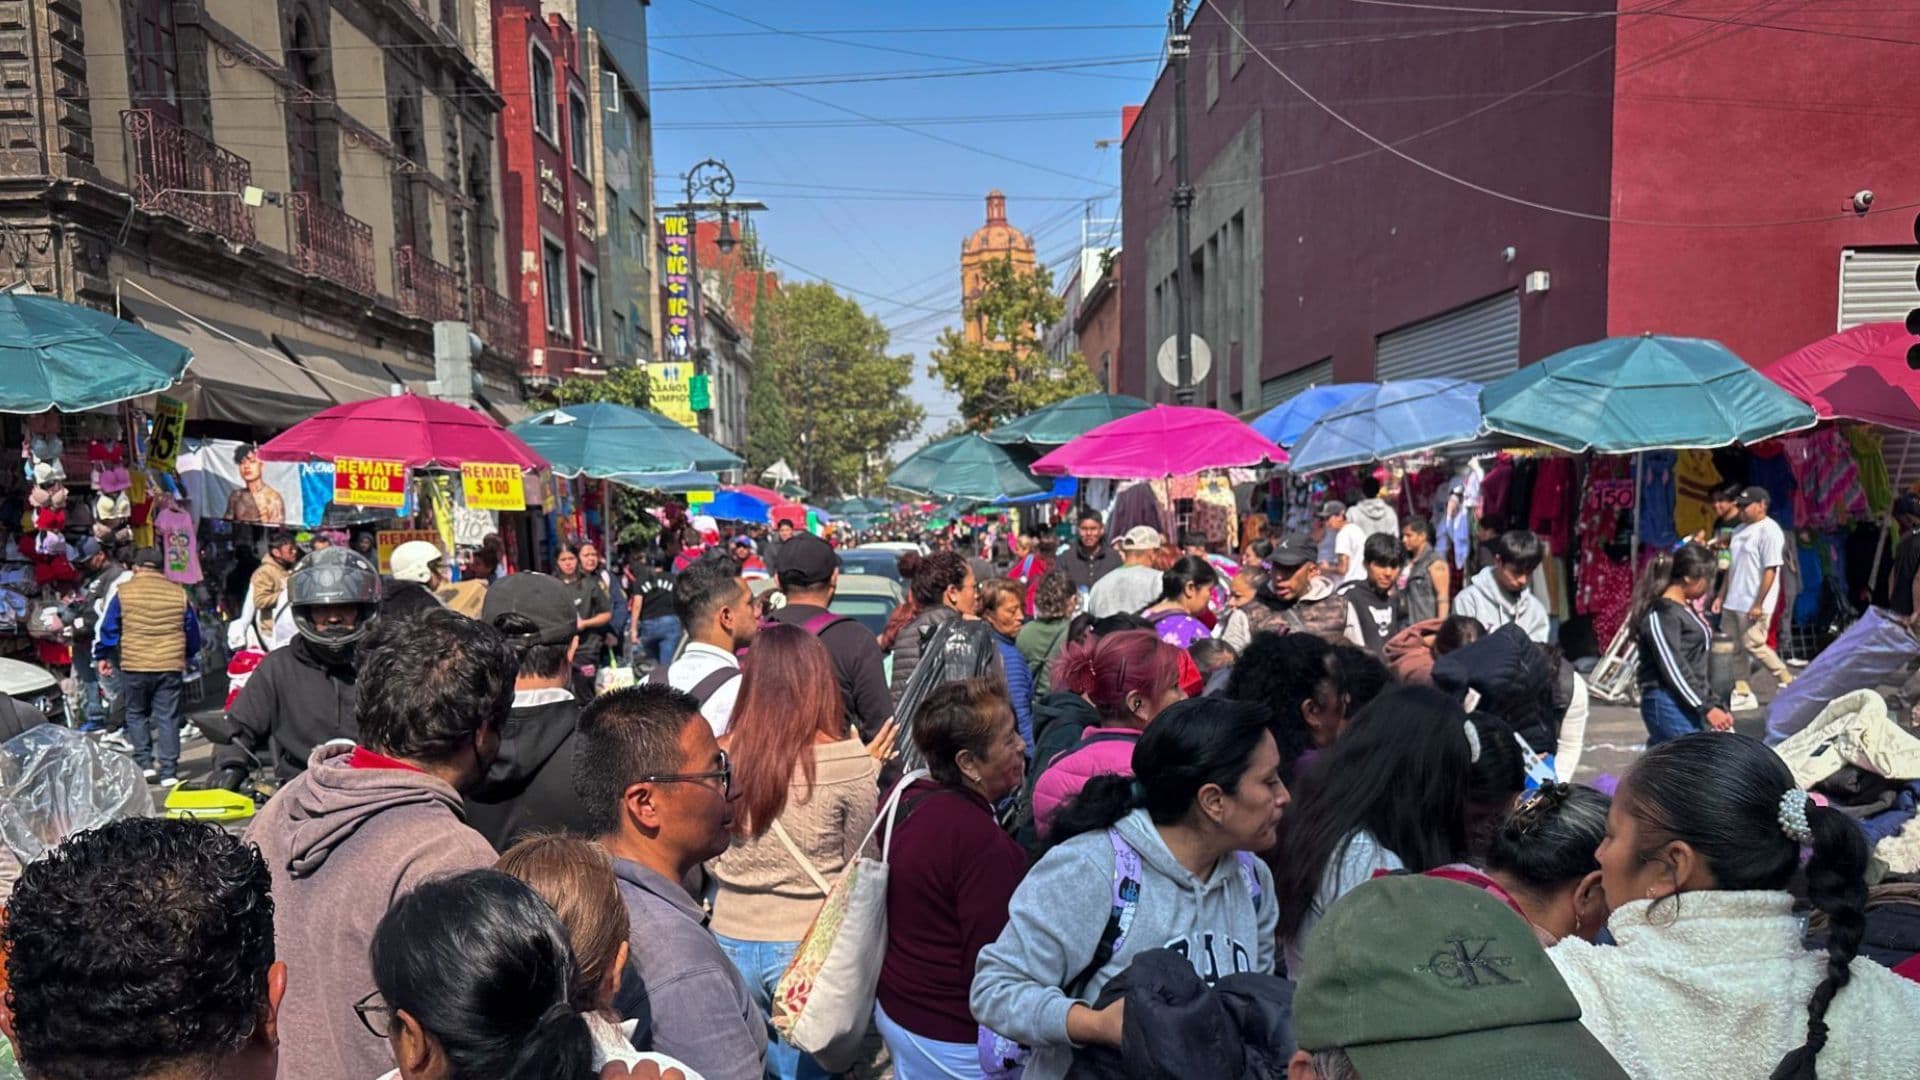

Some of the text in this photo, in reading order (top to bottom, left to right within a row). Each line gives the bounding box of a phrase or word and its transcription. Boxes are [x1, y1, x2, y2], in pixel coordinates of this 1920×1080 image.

[665, 216, 688, 236] WC
[666, 256, 688, 275] WC
[668, 297, 688, 317] WC
[336, 459, 404, 477] REMATE
[463, 465, 519, 480] REMATE
[350, 474, 389, 491] $ 100
[476, 479, 509, 494] $ 100
